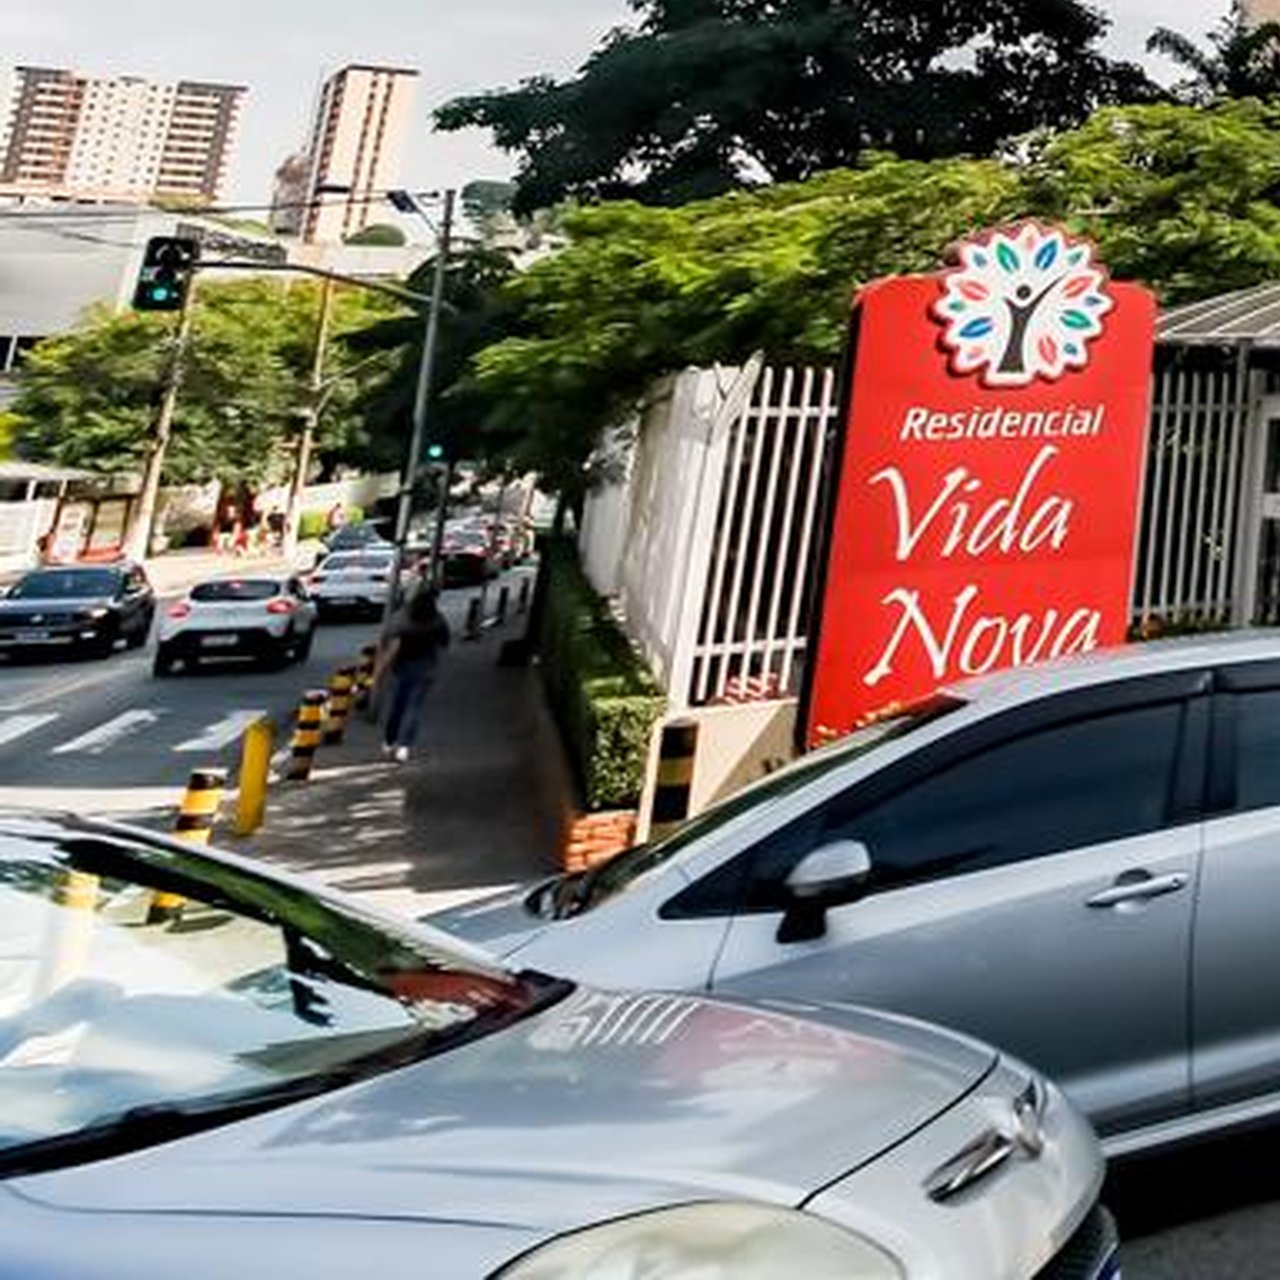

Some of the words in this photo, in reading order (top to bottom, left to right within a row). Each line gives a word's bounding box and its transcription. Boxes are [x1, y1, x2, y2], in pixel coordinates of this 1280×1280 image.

[900, 405, 1105, 440] Residencial
[868, 444, 1073, 561] Vida
[864, 585, 1101, 686] Nova
